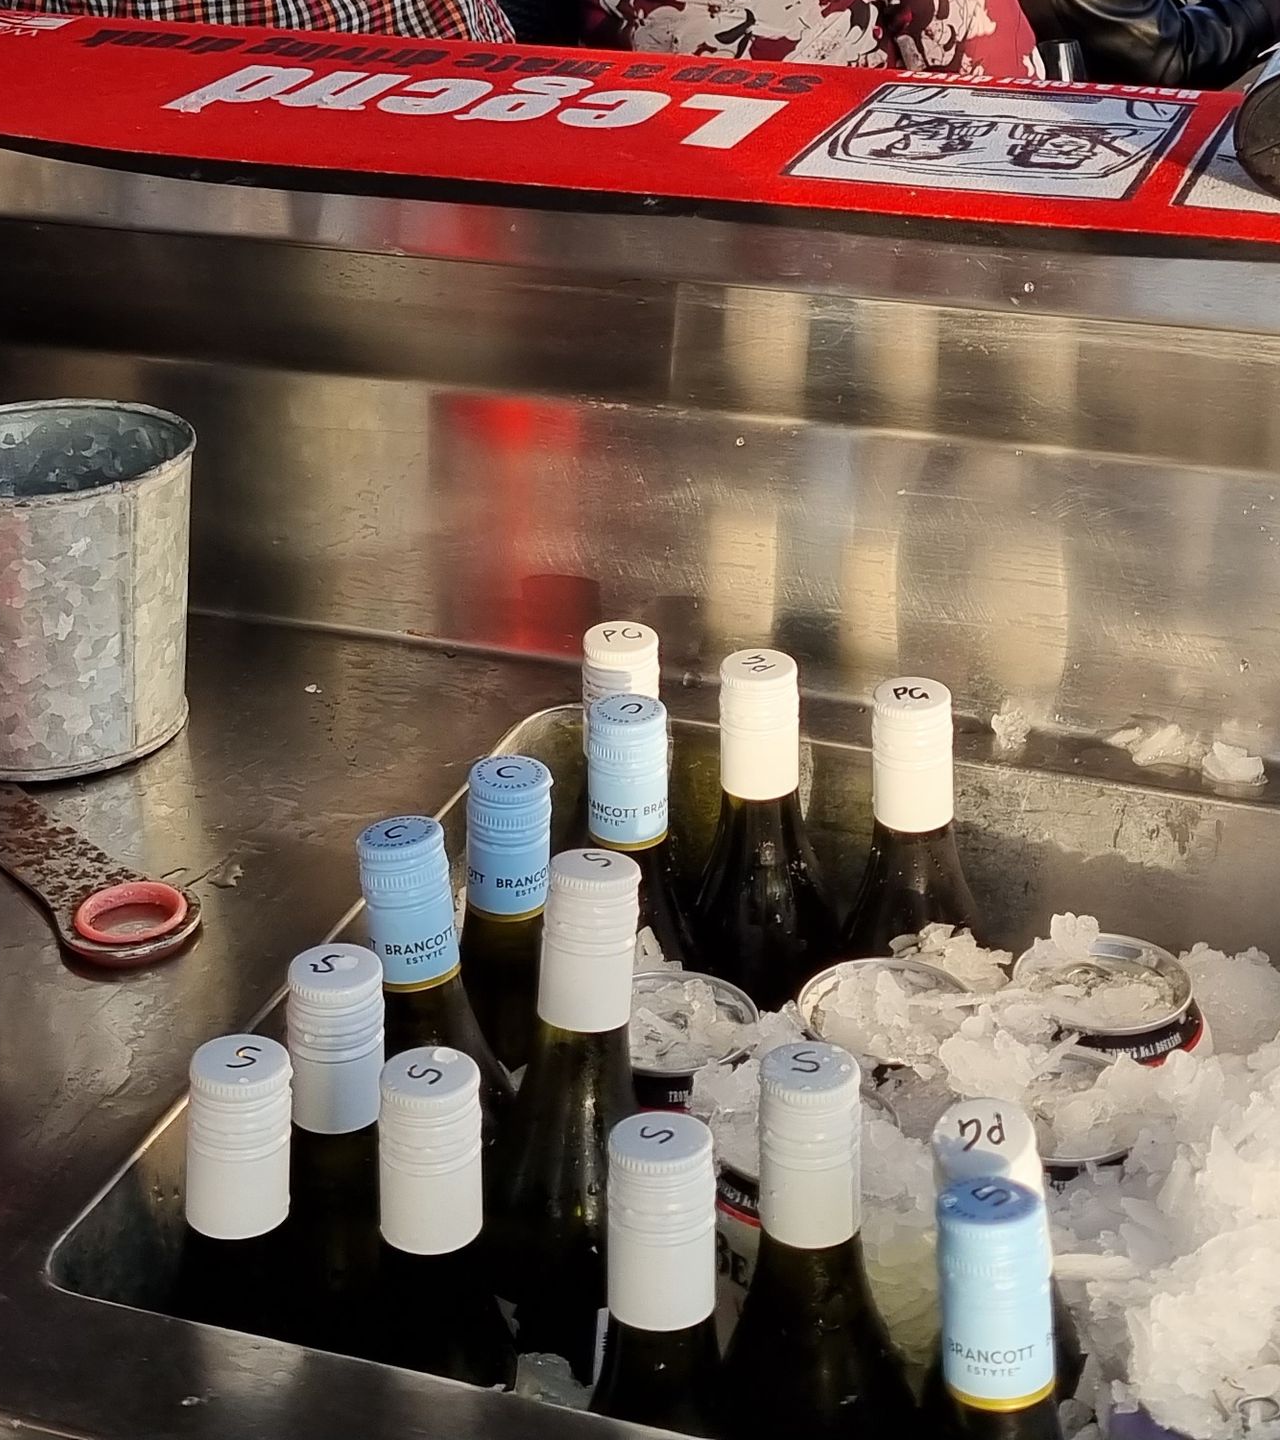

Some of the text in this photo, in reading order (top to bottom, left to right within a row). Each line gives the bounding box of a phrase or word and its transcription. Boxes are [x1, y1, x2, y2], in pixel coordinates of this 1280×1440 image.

[78, 29, 822, 95] Stop a mate driving drunk
[896, 69, 1203, 99] Have a sober driver
[160, 64, 790, 150] Legend
[892, 685, 930, 701] PG
[496, 765, 523, 779] C
[582, 852, 612, 868] S
[384, 925, 453, 956] BRANCOTT
[225, 1045, 262, 1069] S
[790, 1050, 820, 1074] S
[406, 1063, 444, 1086] S
[639, 1125, 675, 1145] S
